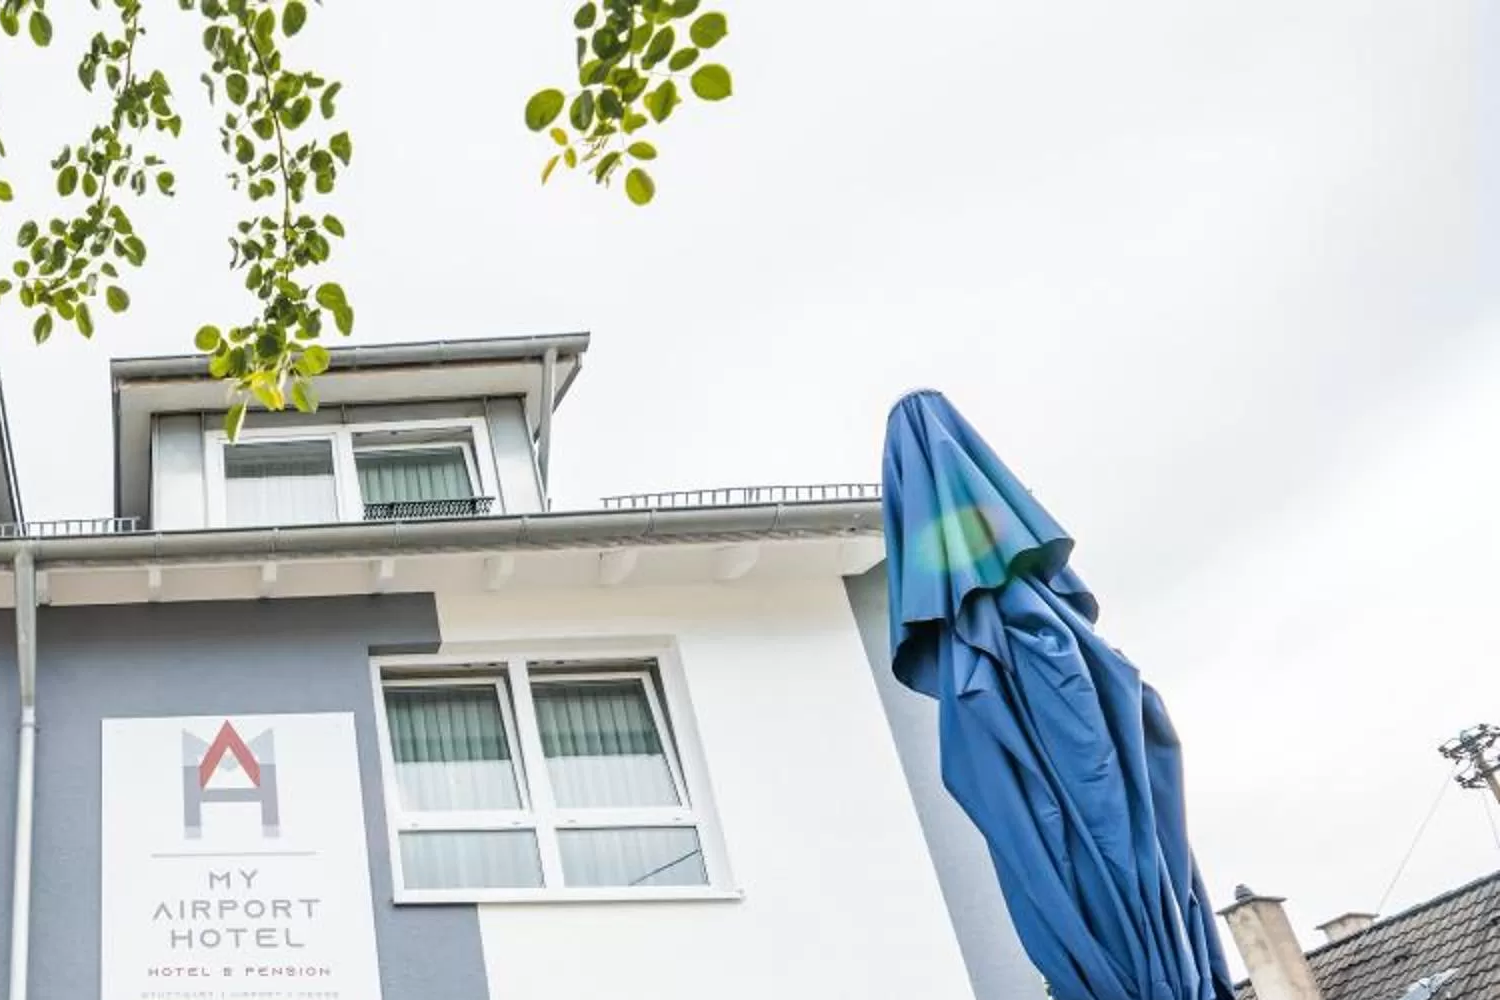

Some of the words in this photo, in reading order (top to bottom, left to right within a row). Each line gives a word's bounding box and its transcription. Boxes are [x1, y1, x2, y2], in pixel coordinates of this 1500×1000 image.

[208, 869, 258, 890] MY
[152, 898, 321, 920] AIRPORT
[170, 927, 306, 949] HOTEL
[147, 966, 211, 977] HOTEL
[245, 966, 332, 977] PENSION
